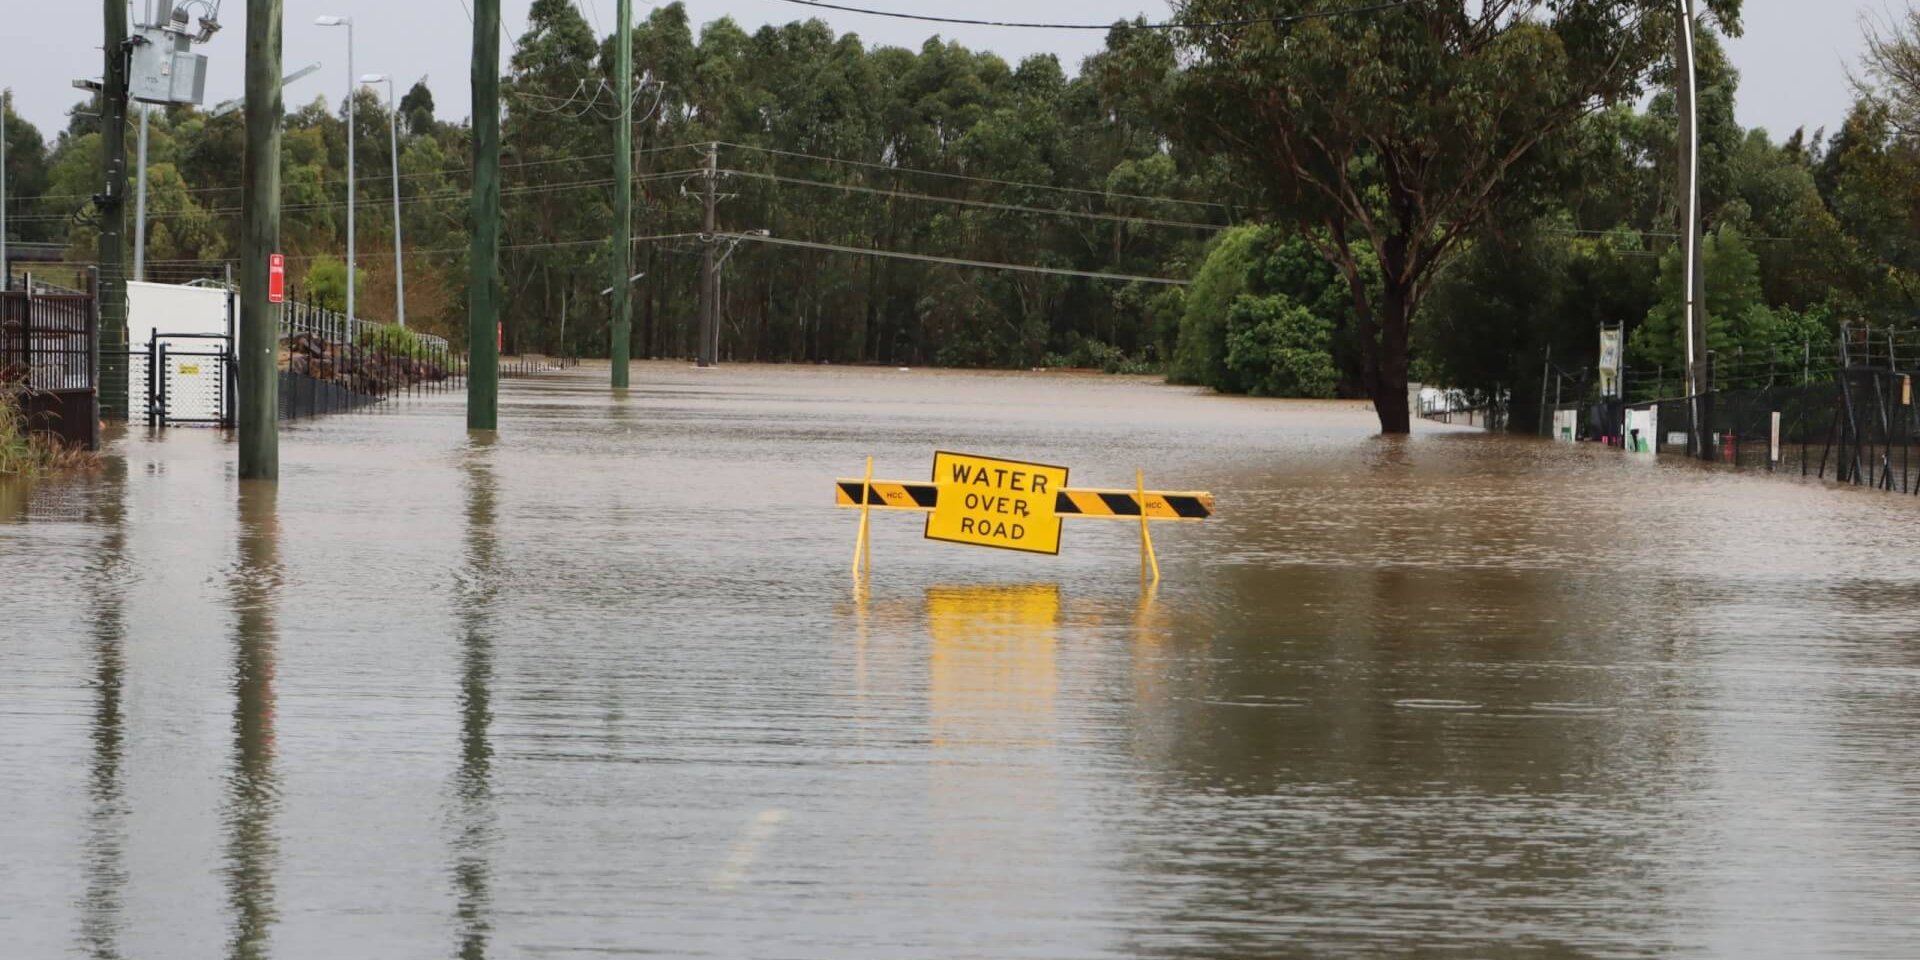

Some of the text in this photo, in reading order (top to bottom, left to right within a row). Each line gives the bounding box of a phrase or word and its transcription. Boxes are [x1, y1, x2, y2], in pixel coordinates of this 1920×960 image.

[952, 464, 1048, 494] WATER
[886, 491, 903, 499] HCC
[965, 494, 1028, 516] OVER
[961, 517, 1025, 541] ROAD
